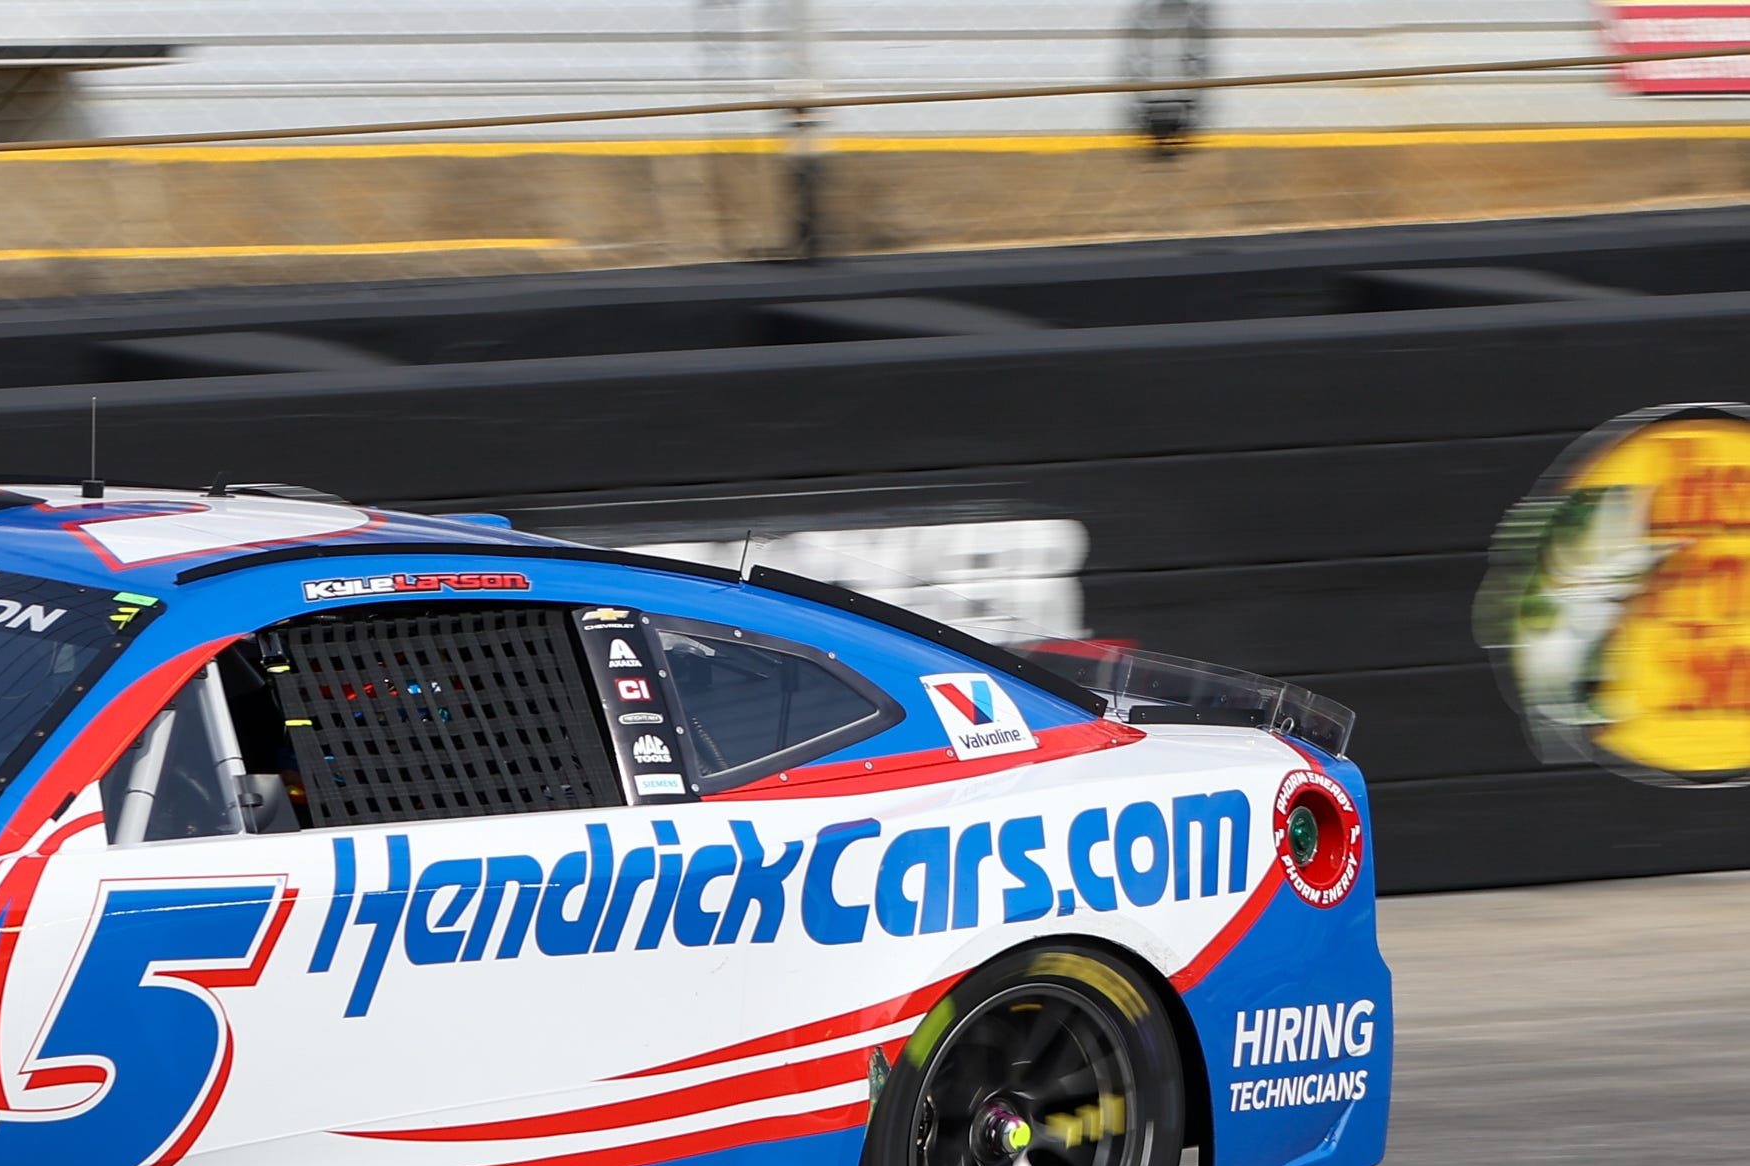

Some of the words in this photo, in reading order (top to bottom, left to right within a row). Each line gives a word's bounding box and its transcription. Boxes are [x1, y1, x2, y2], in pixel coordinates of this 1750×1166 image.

[633, 734, 670, 755] MAC
[634, 754, 673, 763] TOOLS
[959, 729, 1022, 750] Valvoline
[642, 780, 679, 788] SIEMENS
[1277, 772, 1307, 815] PHORM
[1306, 772, 1354, 812] ENERGY
[1281, 854, 1321, 903] PHORM
[1322, 851, 1358, 904] ENERGY
[307, 788, 1252, 1020] HendrickCars.com
[1233, 999, 1376, 1068] HIRING
[1230, 1069, 1369, 1112] TECHNICIANS
